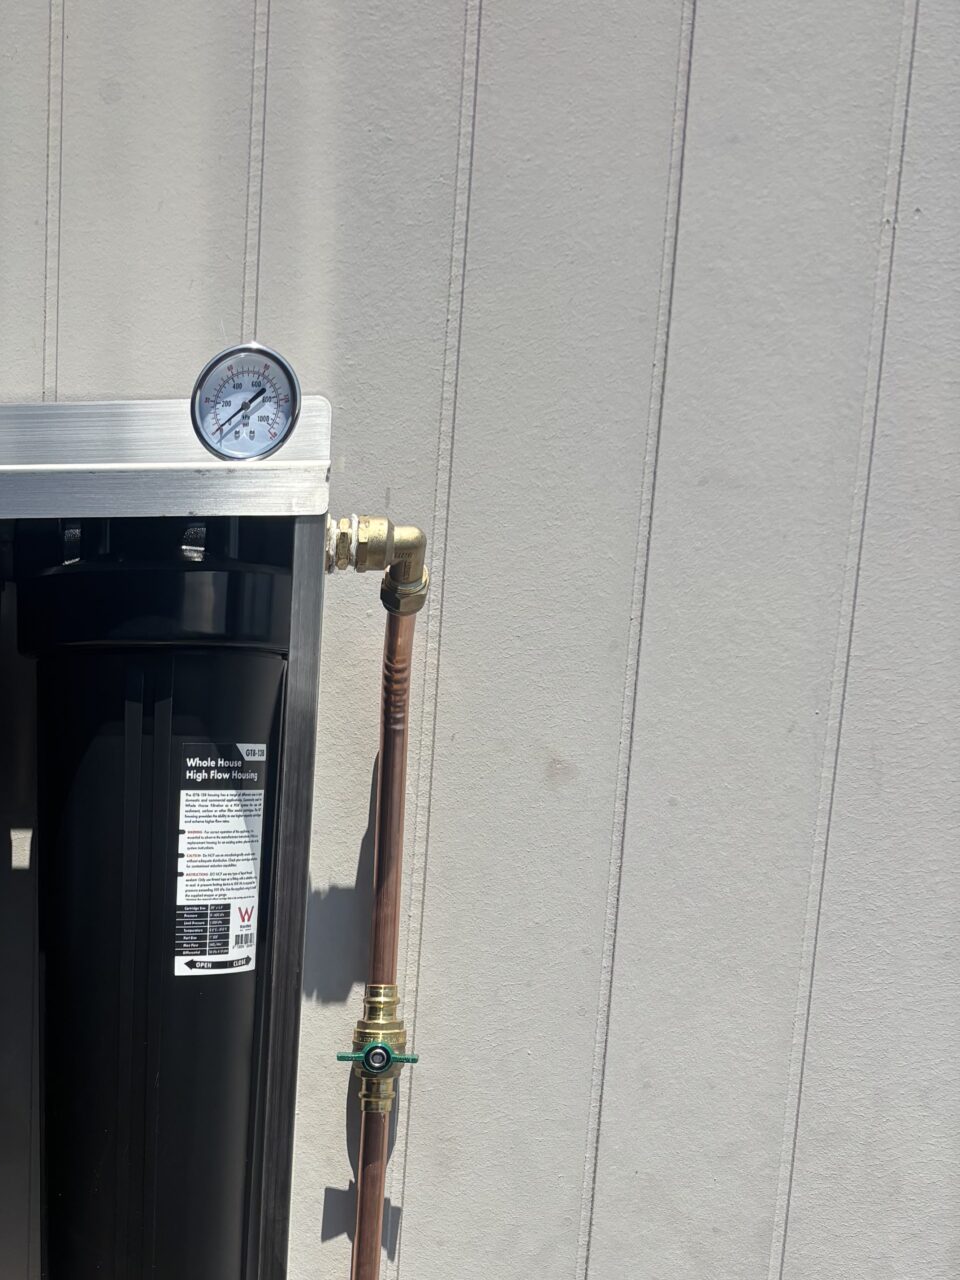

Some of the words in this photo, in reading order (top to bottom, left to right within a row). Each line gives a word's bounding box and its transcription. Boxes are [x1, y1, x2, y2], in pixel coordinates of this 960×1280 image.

[186, 757, 216, 767] Whole
[217, 758, 242, 767] House
[186, 770, 208, 782] High
[210, 770, 230, 780] Flow
[232, 770, 258, 781] Housing
